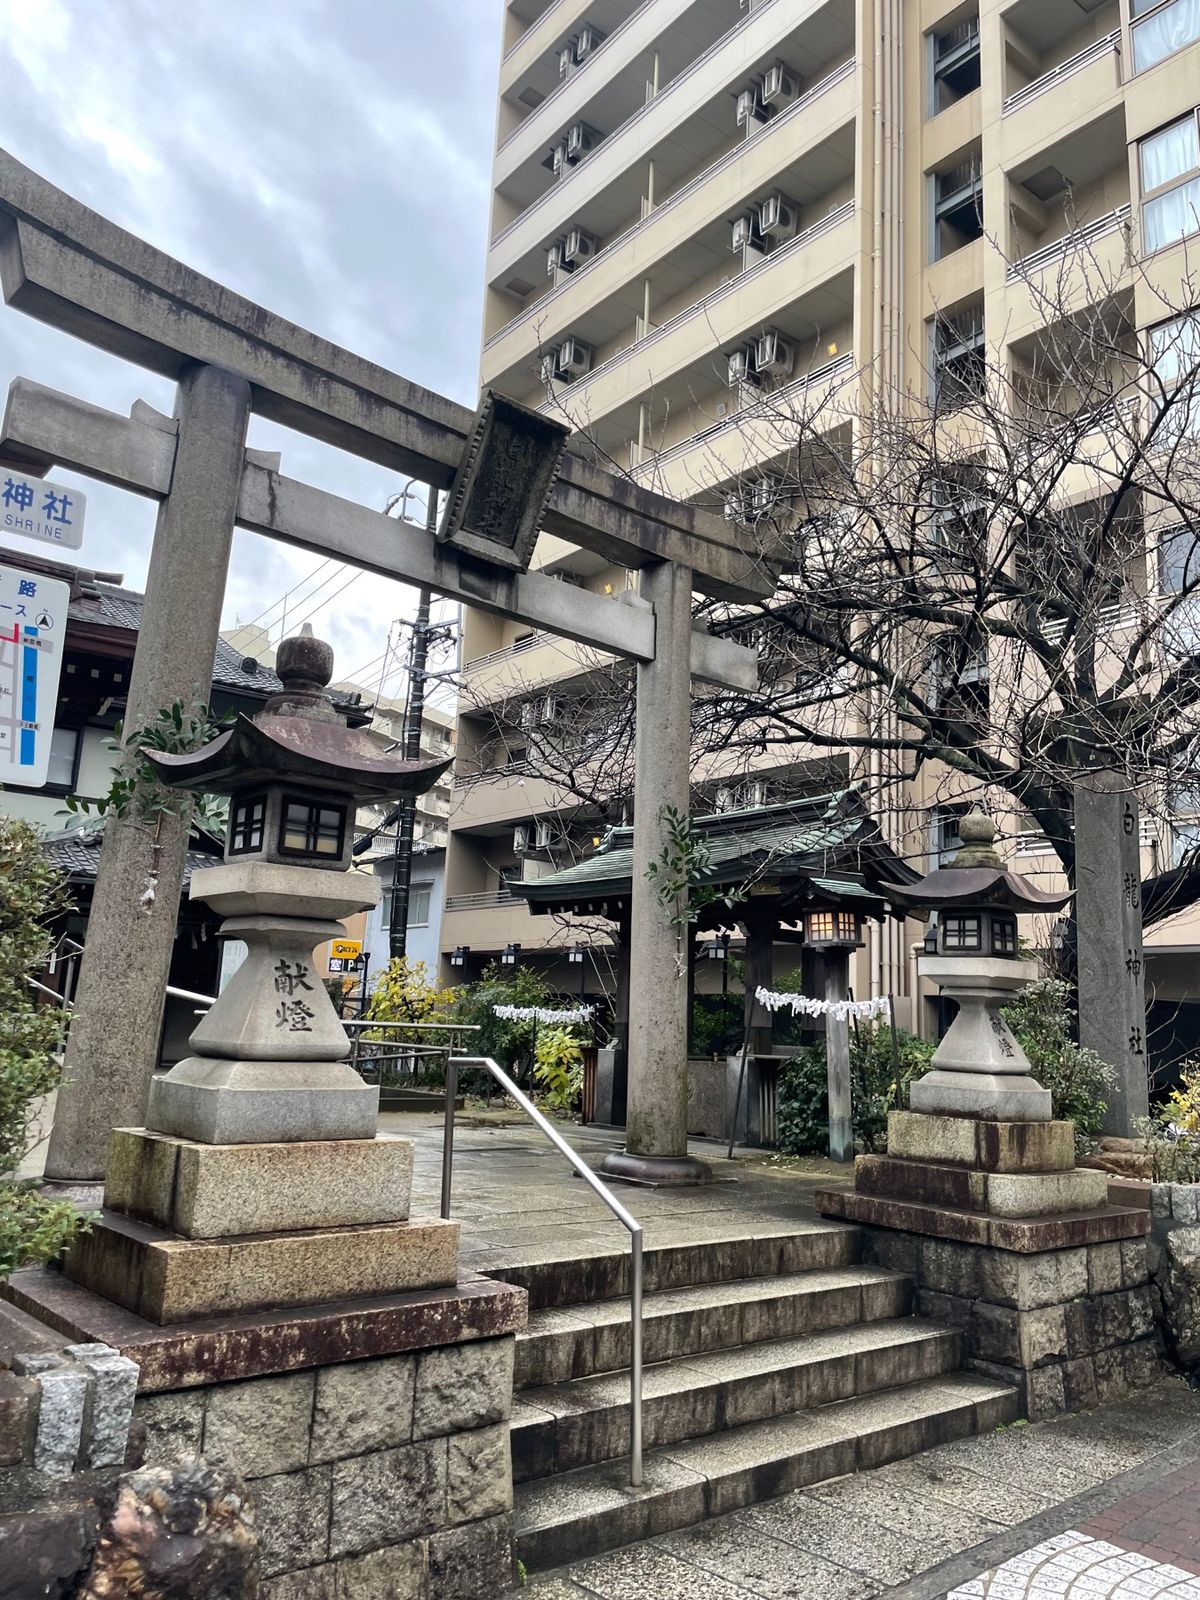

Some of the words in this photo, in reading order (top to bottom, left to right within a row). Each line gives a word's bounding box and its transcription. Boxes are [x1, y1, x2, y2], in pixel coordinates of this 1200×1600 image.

[2, 478, 73, 525] 神社
[5, 514, 62, 539] SHRINE
[347, 959, 354, 971] P
[274, 959, 316, 1032] 献燈
